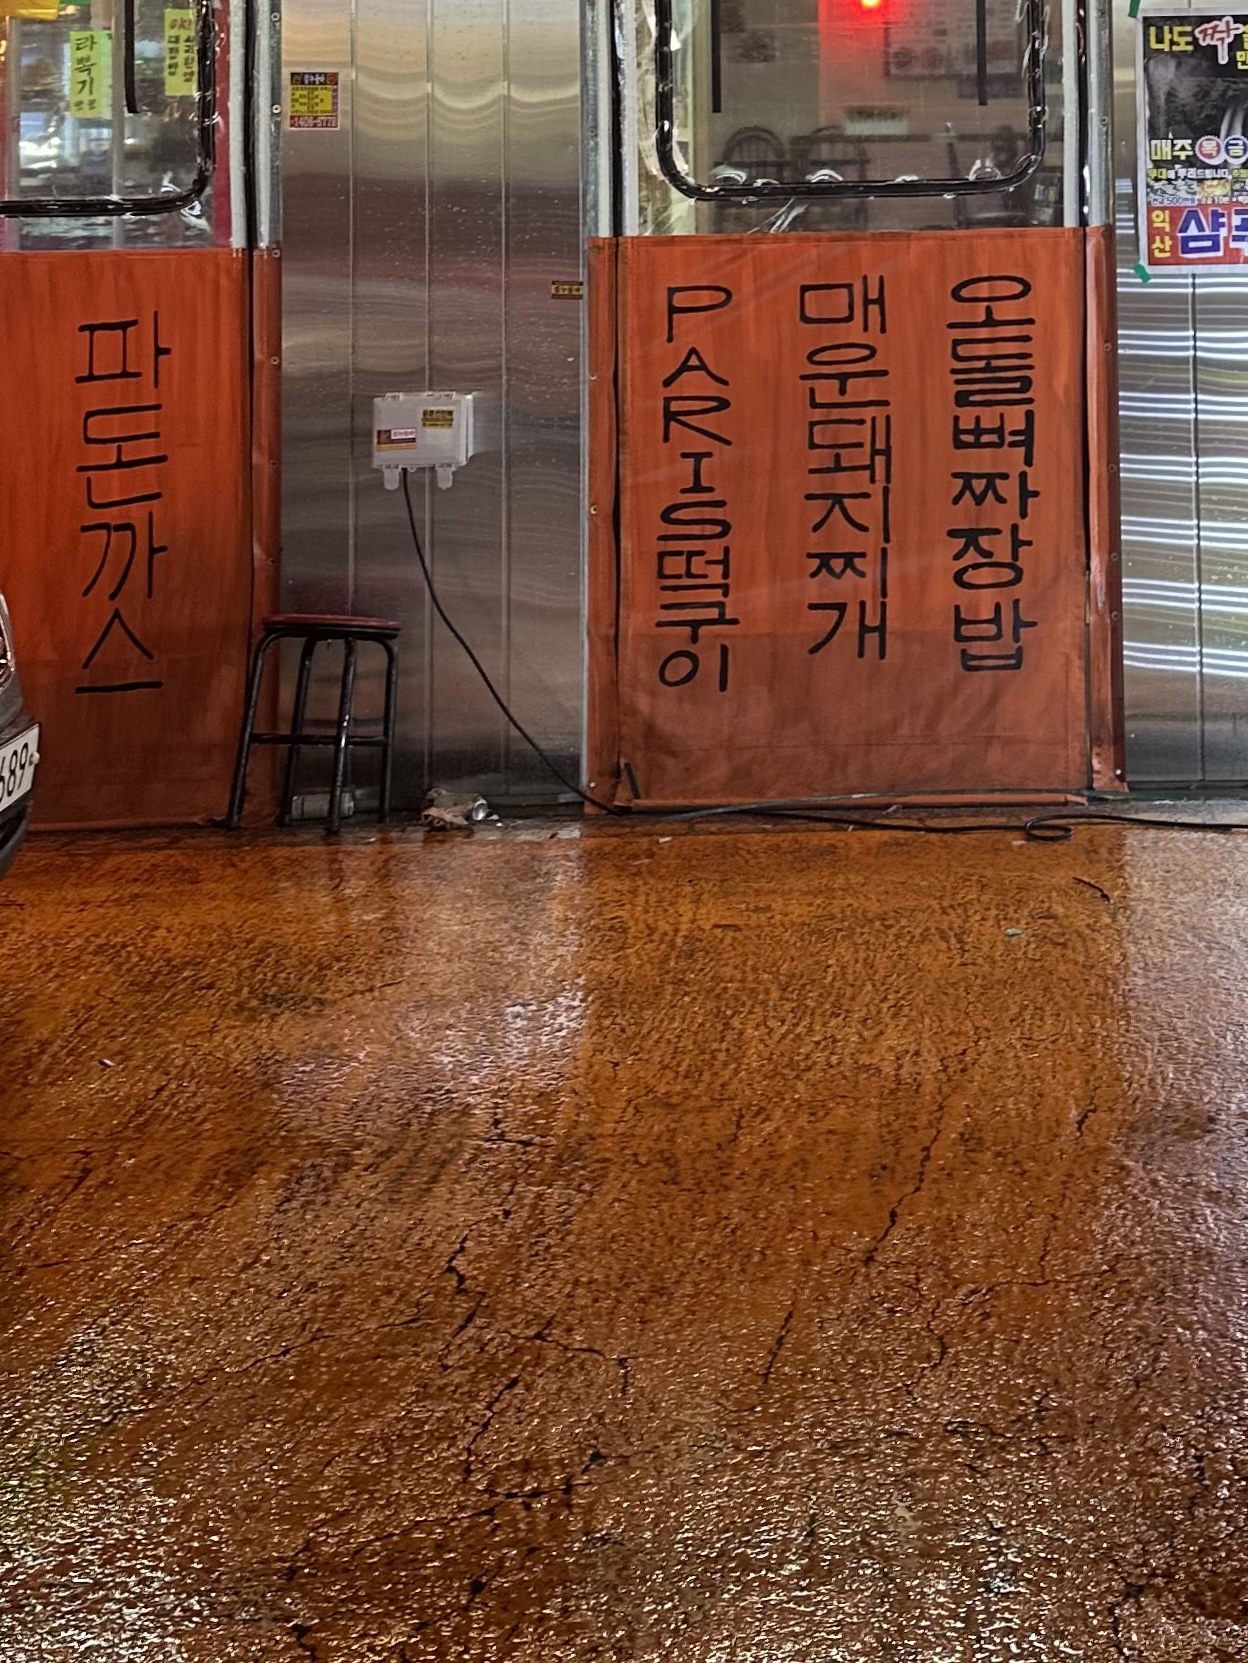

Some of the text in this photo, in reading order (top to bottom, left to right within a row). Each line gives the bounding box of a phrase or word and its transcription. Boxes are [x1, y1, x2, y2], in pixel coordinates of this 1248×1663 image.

[1150, 25, 1194, 52] 나도
[1151, 139, 1193, 161] 매주
[74, 310, 172, 694] 파돈까스
